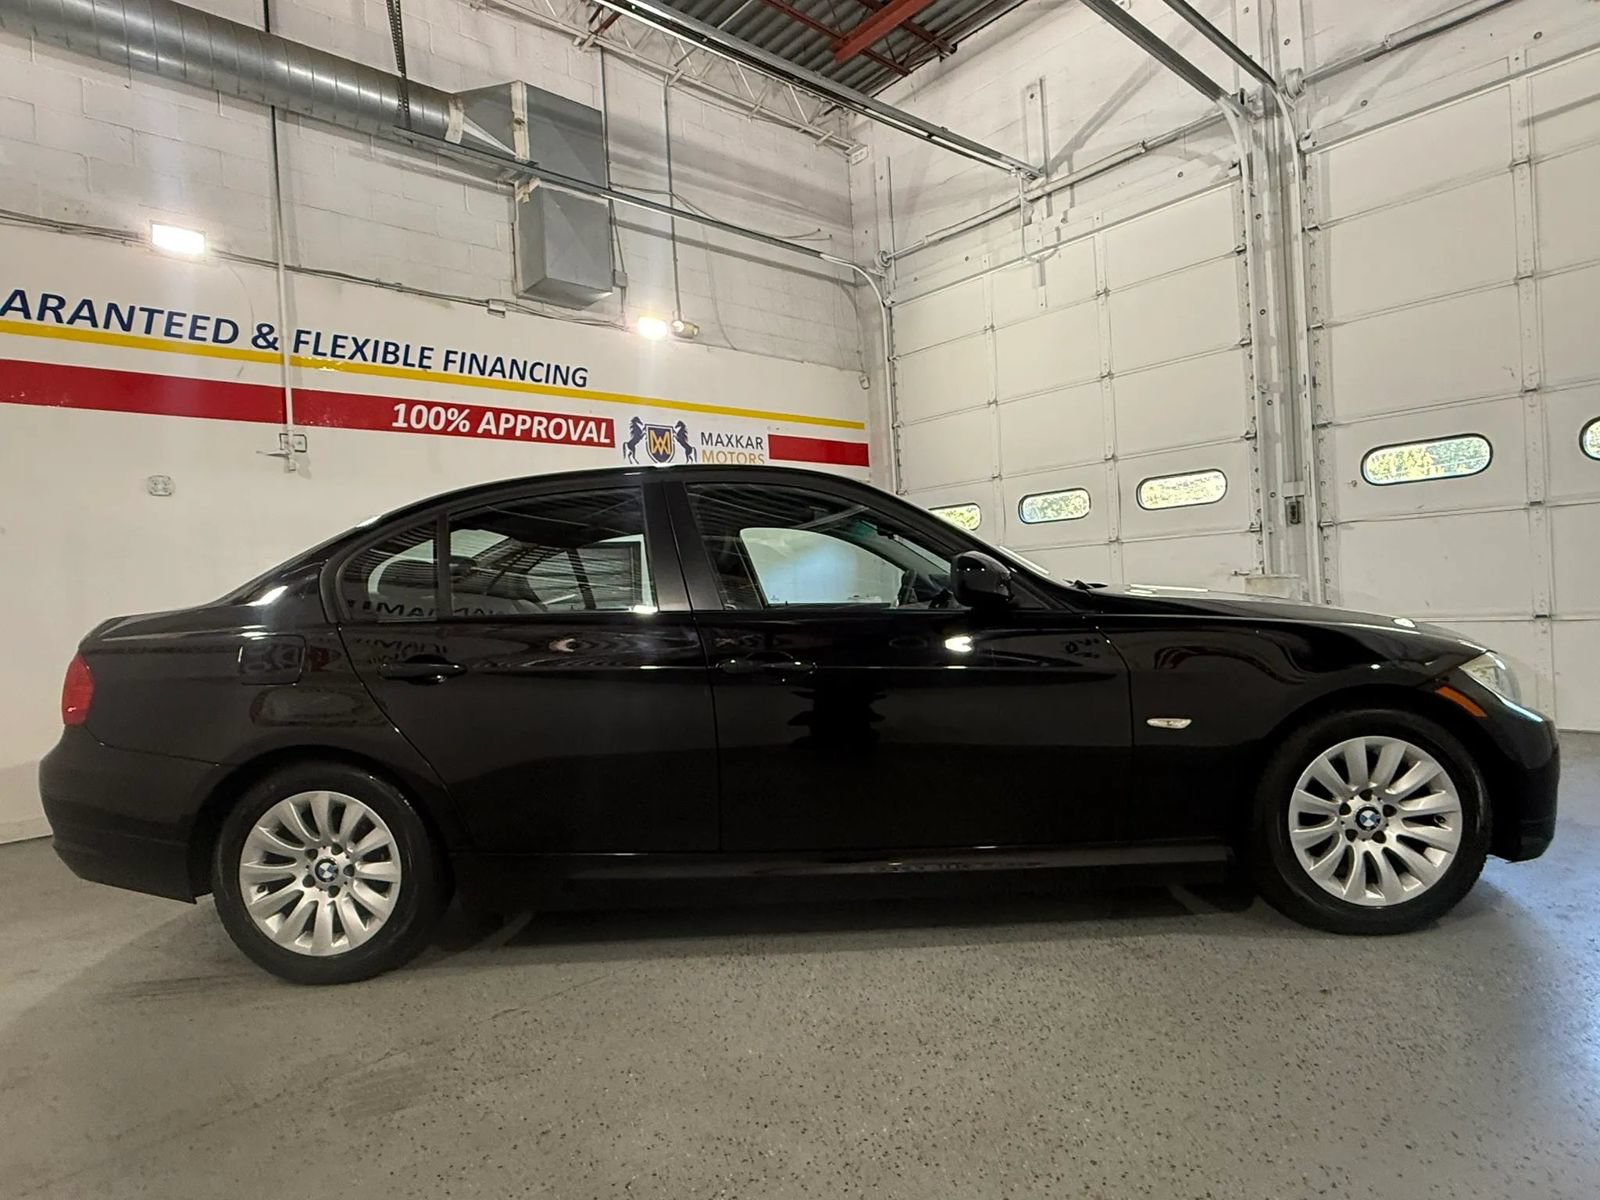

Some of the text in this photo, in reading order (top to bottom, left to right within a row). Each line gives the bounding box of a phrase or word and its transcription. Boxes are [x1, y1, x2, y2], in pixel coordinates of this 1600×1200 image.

[0, 289, 588, 388] ARANTEED & FLEXIBLE FINANCING
[391, 403, 611, 444] 100% APPROVAL
[700, 432, 764, 450] MAXKAR
[702, 449, 765, 465] MOTORS
